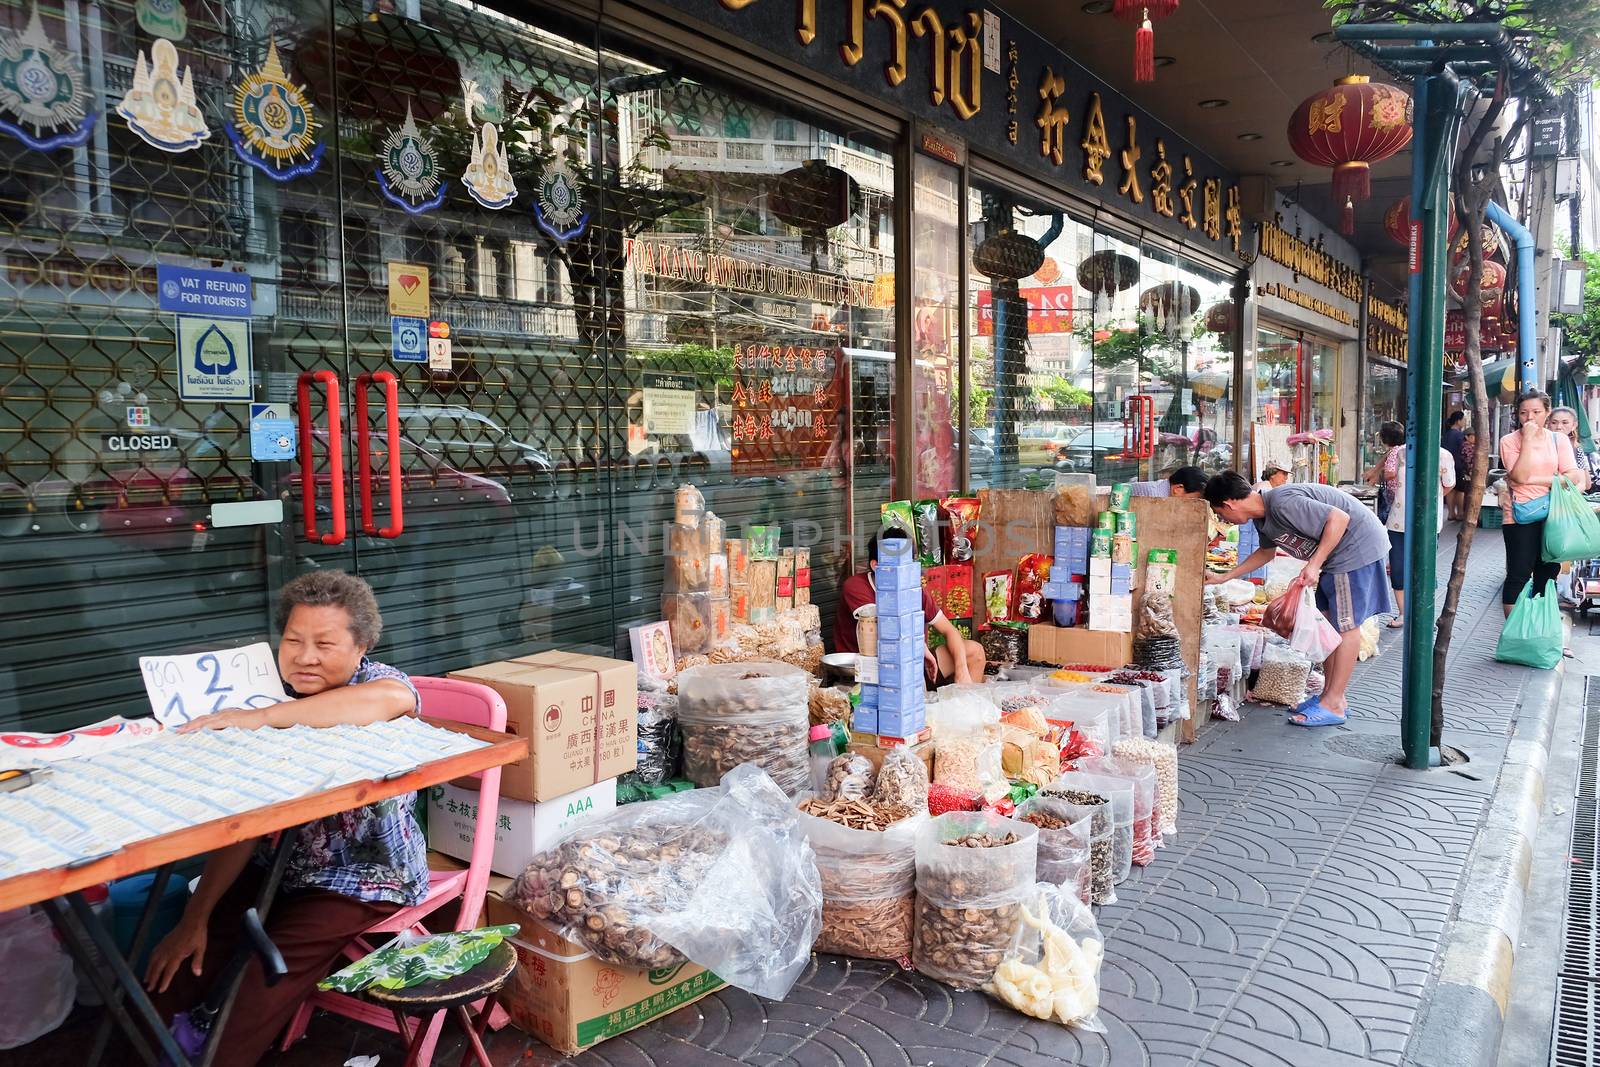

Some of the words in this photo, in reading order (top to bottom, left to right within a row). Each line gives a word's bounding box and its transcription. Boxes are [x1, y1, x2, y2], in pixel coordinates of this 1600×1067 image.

[624, 237, 655, 275] TOA
[659, 243, 704, 283] KANG
[181, 277, 200, 289] VAT
[206, 280, 246, 293] REFUND
[181, 293, 201, 304] FOR
[203, 294, 247, 308] TOURISTS
[108, 435, 172, 451] CLOSED
[196, 653, 234, 696] 2
[581, 689, 615, 713] 中國
[582, 710, 615, 726] CHNA
[563, 748, 584, 760] GUANG
[566, 796, 593, 817] AAA
